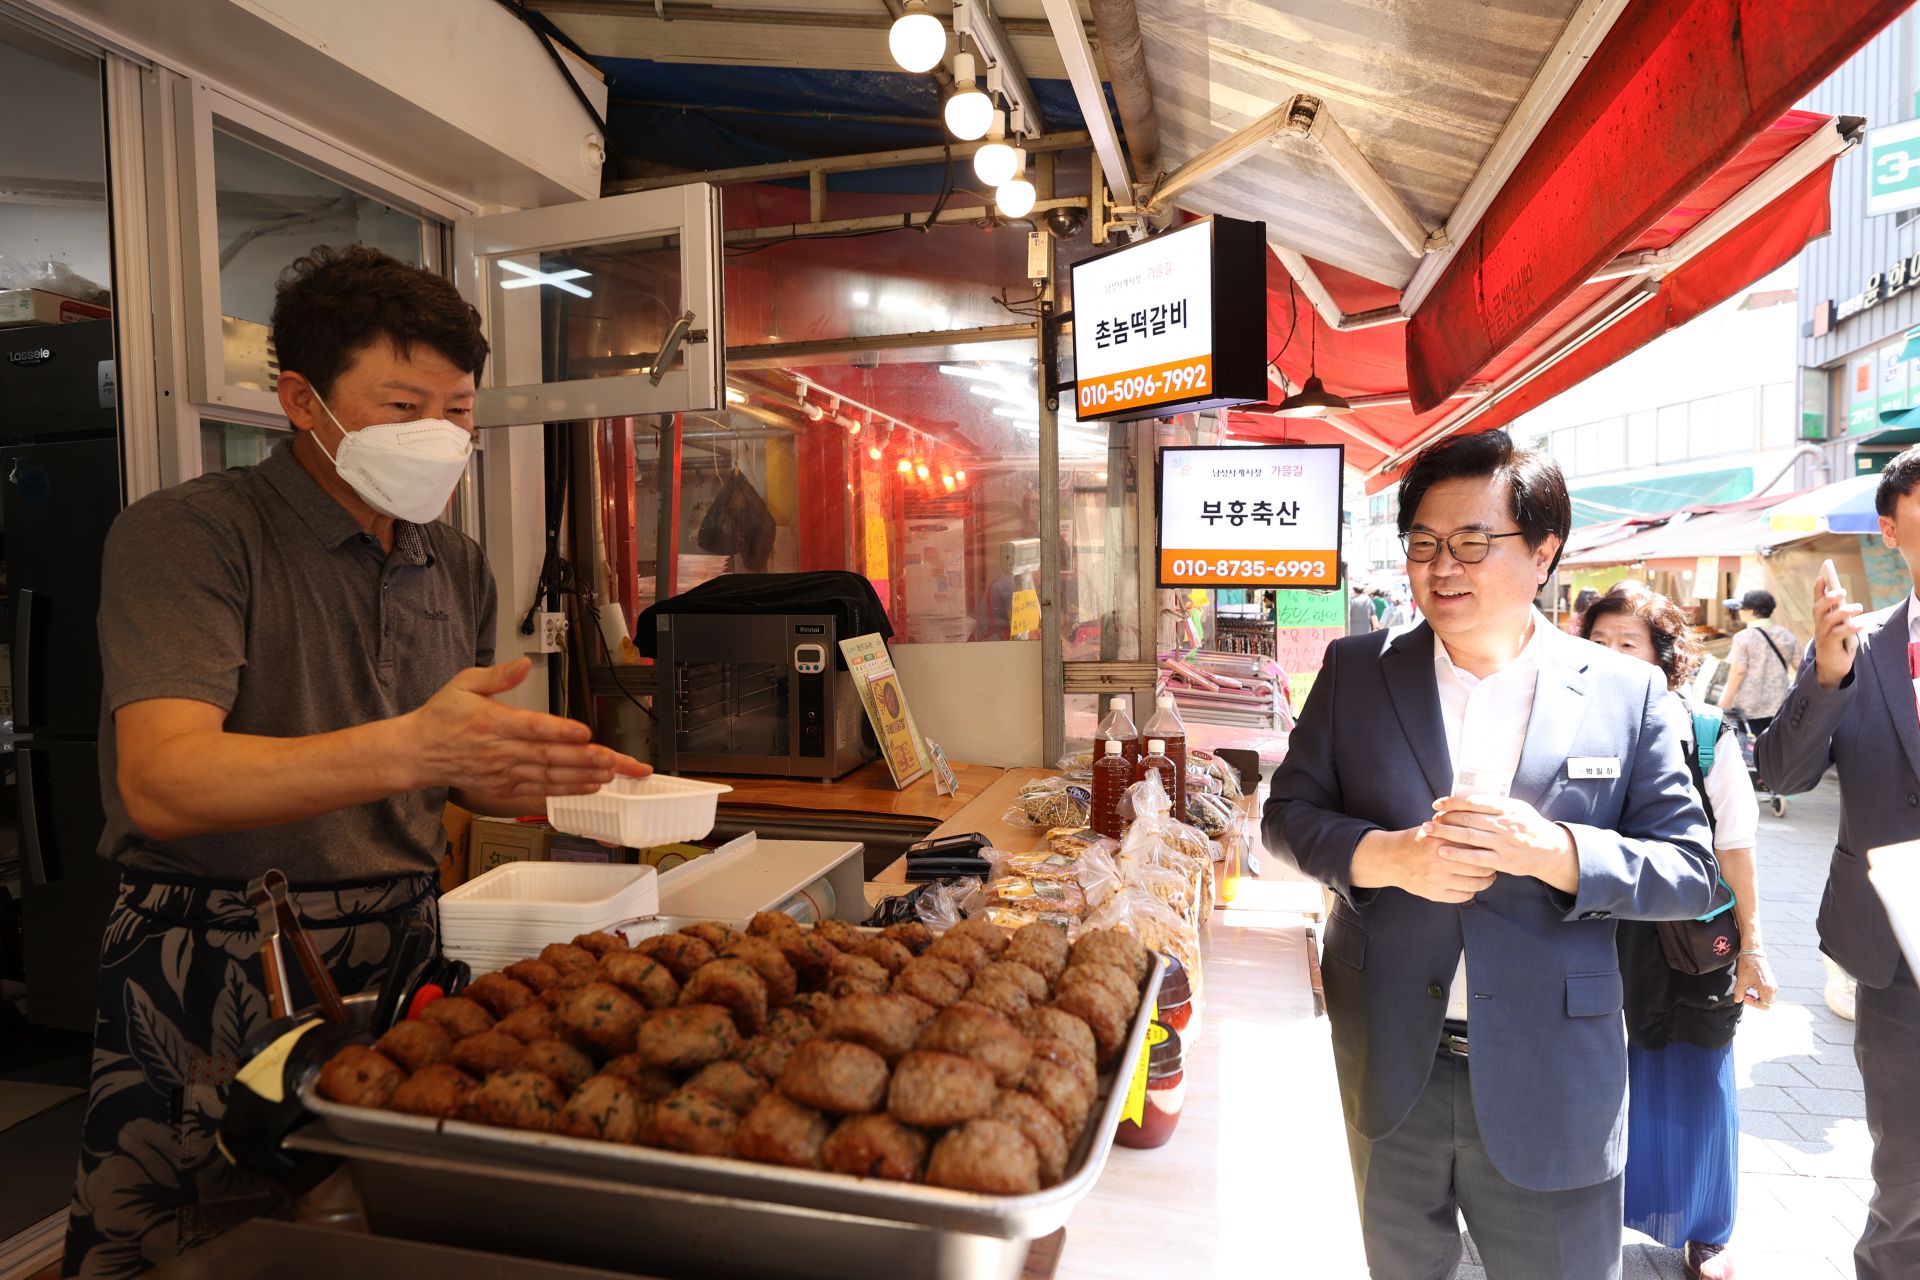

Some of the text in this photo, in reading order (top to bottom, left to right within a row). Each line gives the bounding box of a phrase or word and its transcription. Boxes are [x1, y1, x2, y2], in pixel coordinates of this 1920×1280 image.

[1095, 299, 1187, 349] 촌놈떡갈비
[10, 348, 50, 361] Lassele
[1081, 364, 1207, 408] 010-5096-7992
[1271, 465, 1303, 477] 가을길
[1200, 500, 1300, 526] 부흥축산
[1173, 560, 1325, 578] 010-8735-6993
